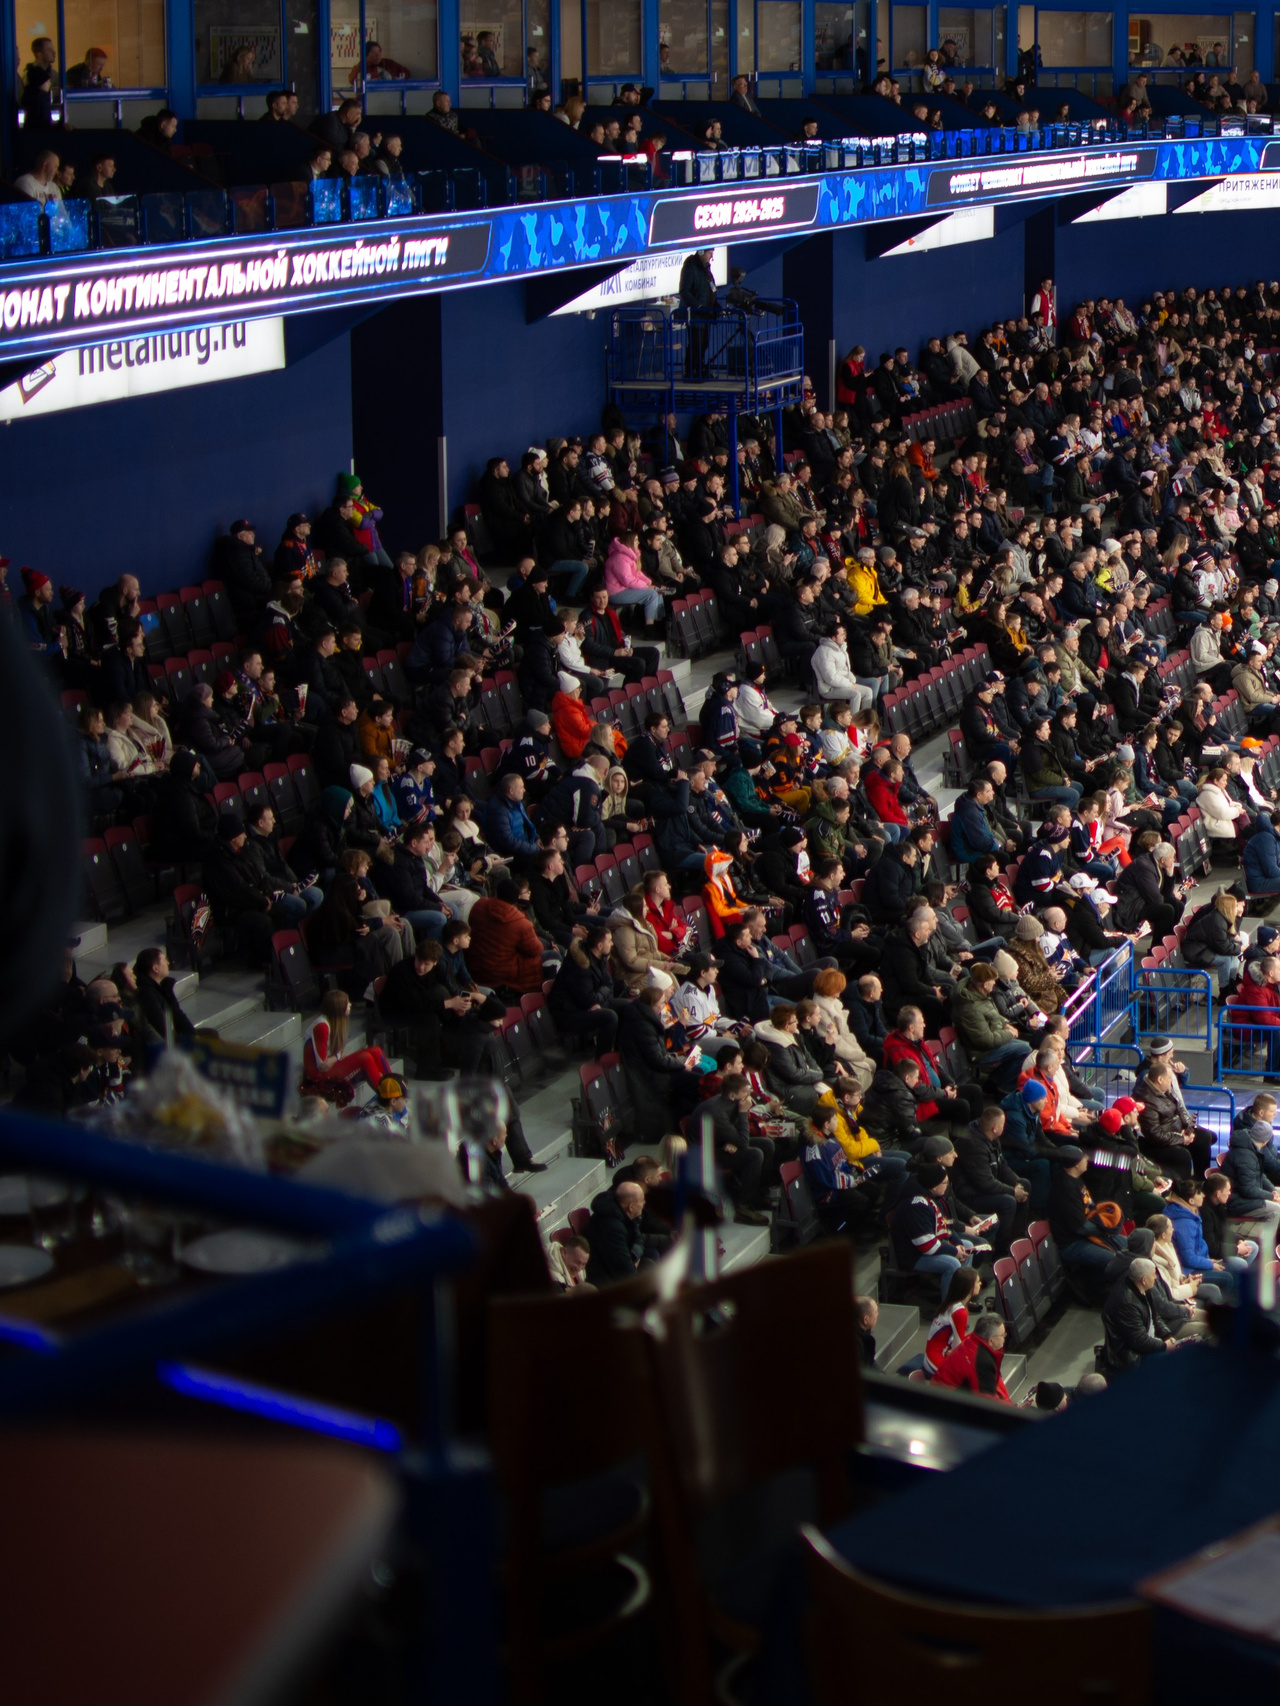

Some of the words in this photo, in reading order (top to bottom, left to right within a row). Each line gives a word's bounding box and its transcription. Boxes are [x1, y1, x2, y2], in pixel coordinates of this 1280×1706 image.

[694, 203, 732, 230] СЕЗОН
[733, 197, 784, 224] 2024-2025
[0, 283, 70, 331] ОНАТ
[73, 248, 288, 318] КОНТИНЕНТАЛЬНОЙ
[290, 235, 401, 287] ХОККЕЙНОЙ
[402, 236, 449, 271] ЛИГИ
[625, 276, 657, 292] КОМБИНАТ
[78, 322, 247, 375] metallurg.ru
